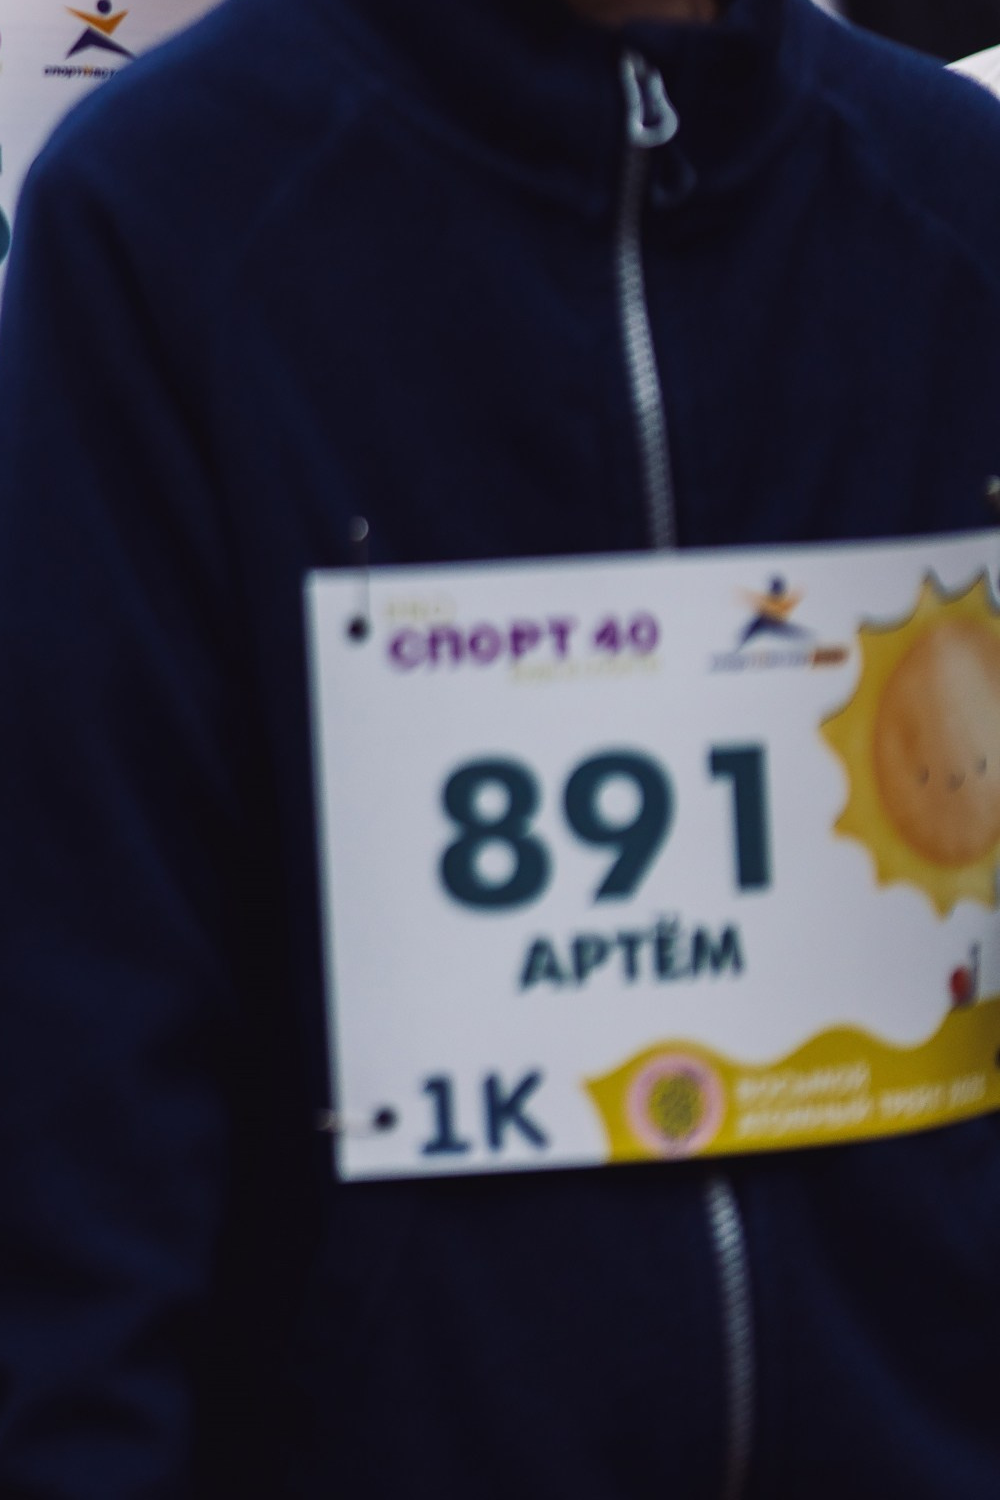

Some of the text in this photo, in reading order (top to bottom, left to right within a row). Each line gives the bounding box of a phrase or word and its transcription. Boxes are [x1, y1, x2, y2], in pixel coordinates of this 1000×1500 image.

[388, 616, 578, 672] СПОРТ
[592, 611, 660, 657] 40
[438, 740, 772, 915] 891
[518, 913, 745, 992] АРТЁМ
